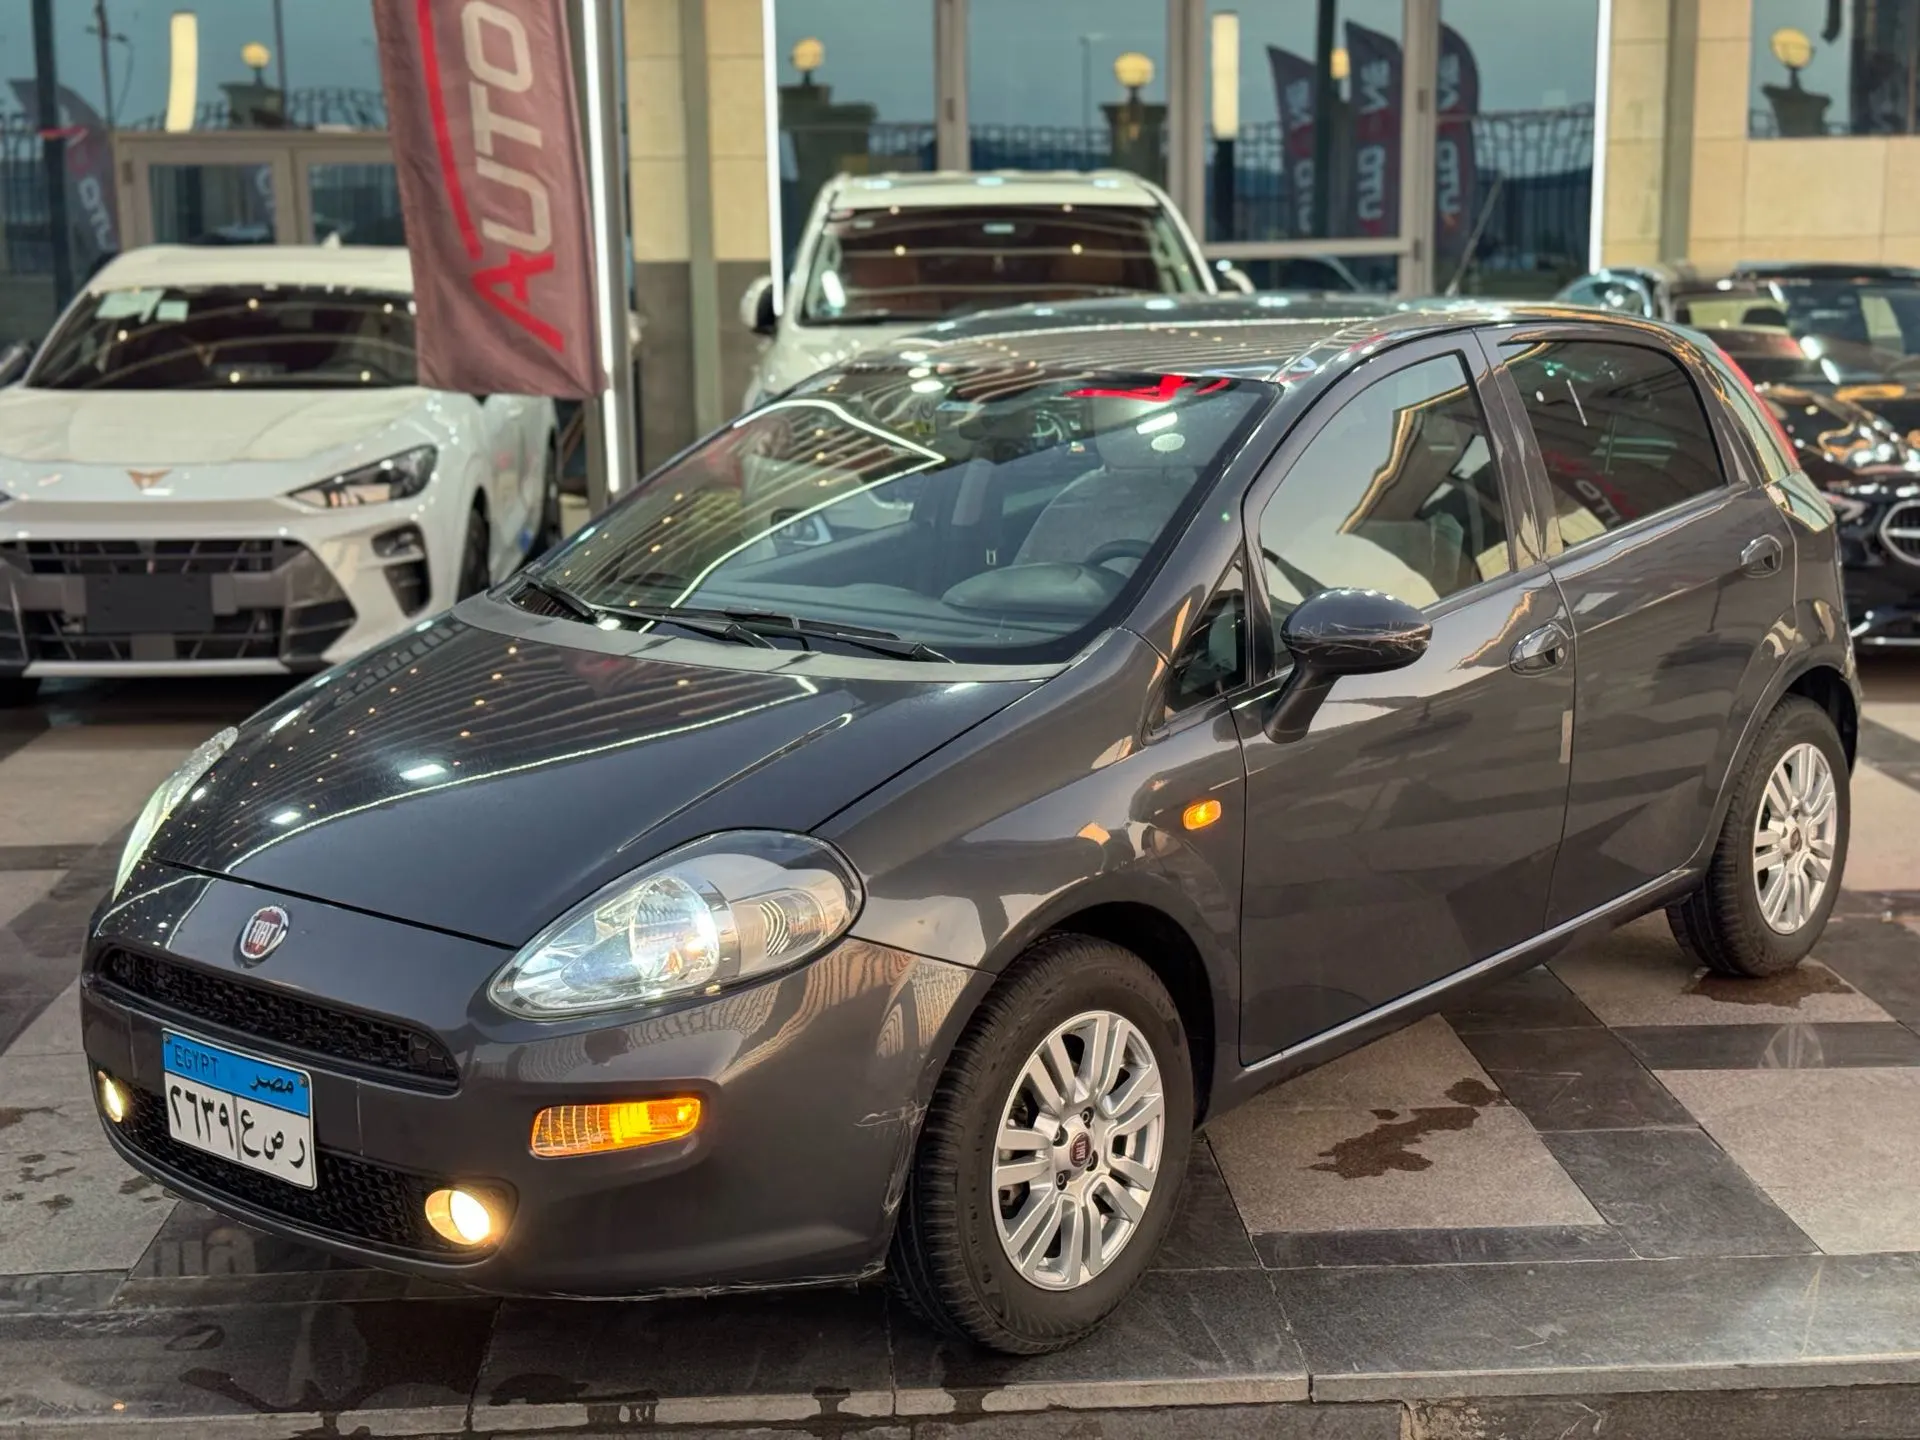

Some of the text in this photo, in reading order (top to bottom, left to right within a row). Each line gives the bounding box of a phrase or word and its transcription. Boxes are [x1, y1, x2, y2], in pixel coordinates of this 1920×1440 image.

[460, 0, 564, 353] AUTO
[248, 920, 279, 946] FIAT
[174, 1045, 219, 1078] EGYPT
[249, 1073, 295, 1095] مصر
